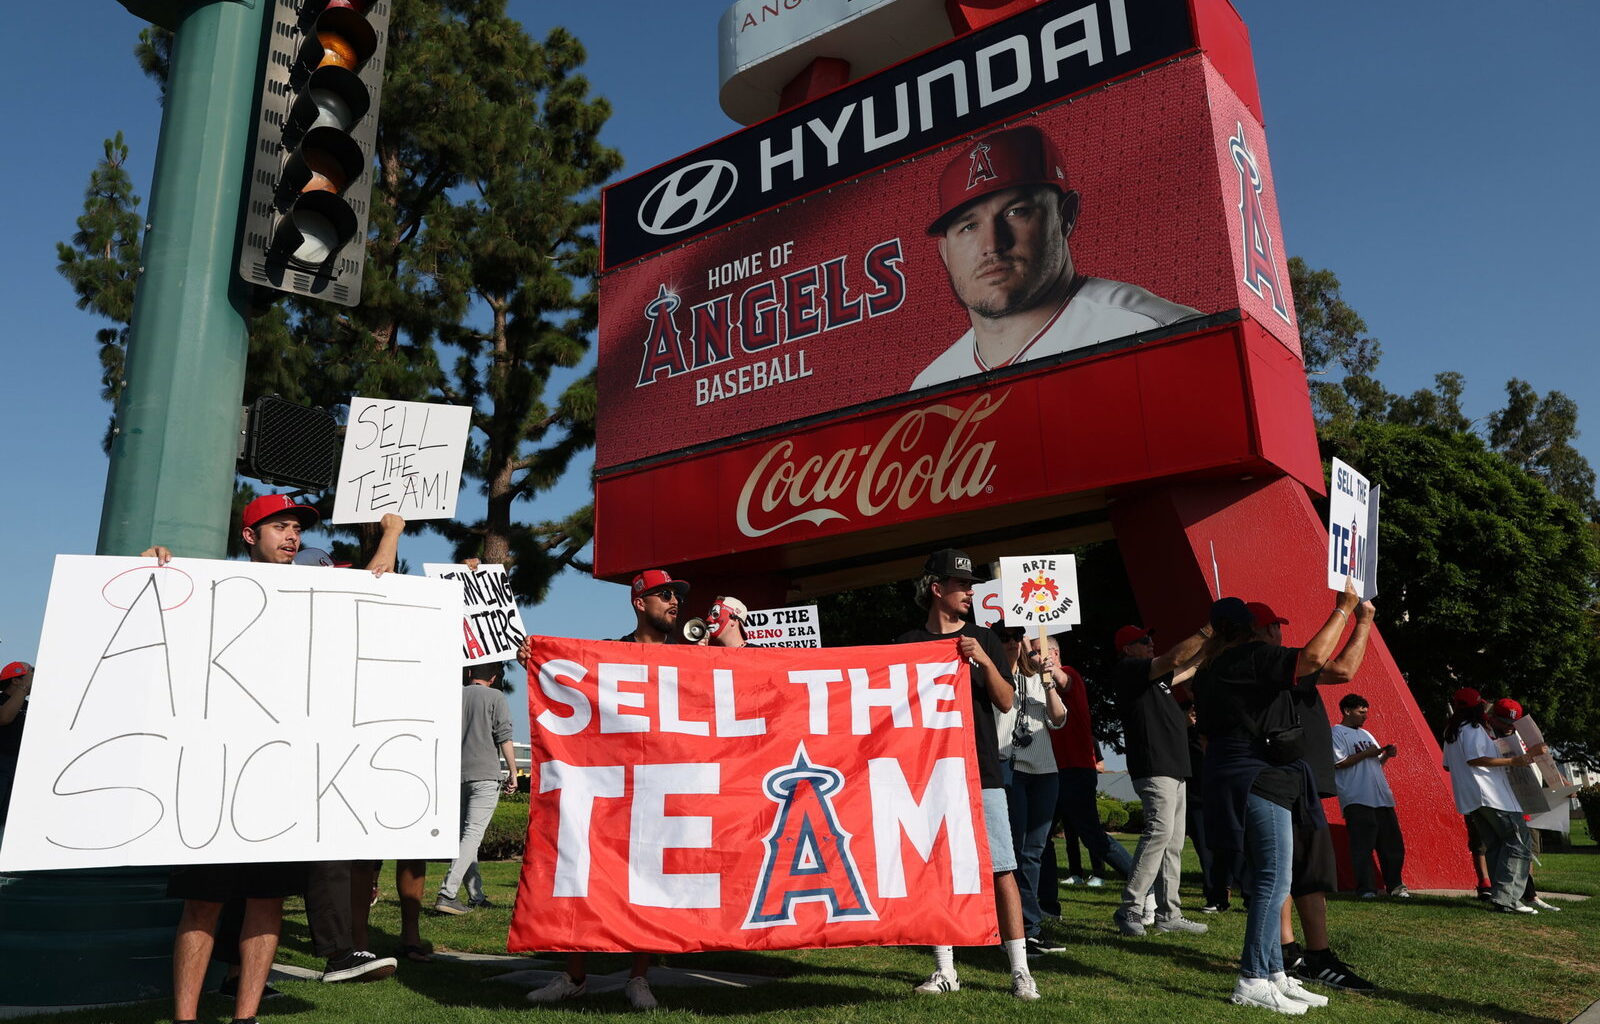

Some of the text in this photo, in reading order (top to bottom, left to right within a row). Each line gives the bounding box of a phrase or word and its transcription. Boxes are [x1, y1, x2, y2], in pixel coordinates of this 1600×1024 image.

[760, 0, 1131, 193] HYUNDAI
[708, 241, 794, 290] HOME OF
[635, 238, 906, 388] ANGELS
[696, 350, 813, 406] BASEBALL
[355, 404, 448, 450] SELL
[381, 452, 420, 481] THE
[736, 387, 1012, 537] Coca-Cola
[1336, 467, 1368, 506] SELL THE
[348, 470, 449, 512] TEAM!
[1022, 559, 1057, 573] ARTE
[1332, 512, 1366, 582] TEAM
[462, 609, 526, 660] ATTERS
[743, 609, 810, 627] ND THE
[745, 626, 816, 640] RENO ERA
[1011, 596, 1074, 623] IS A CLOWN
[69, 565, 442, 731] ARTE
[536, 658, 963, 738] SELL THE
[45, 732, 441, 851] SUCKS!
[539, 740, 982, 930] TEAM
